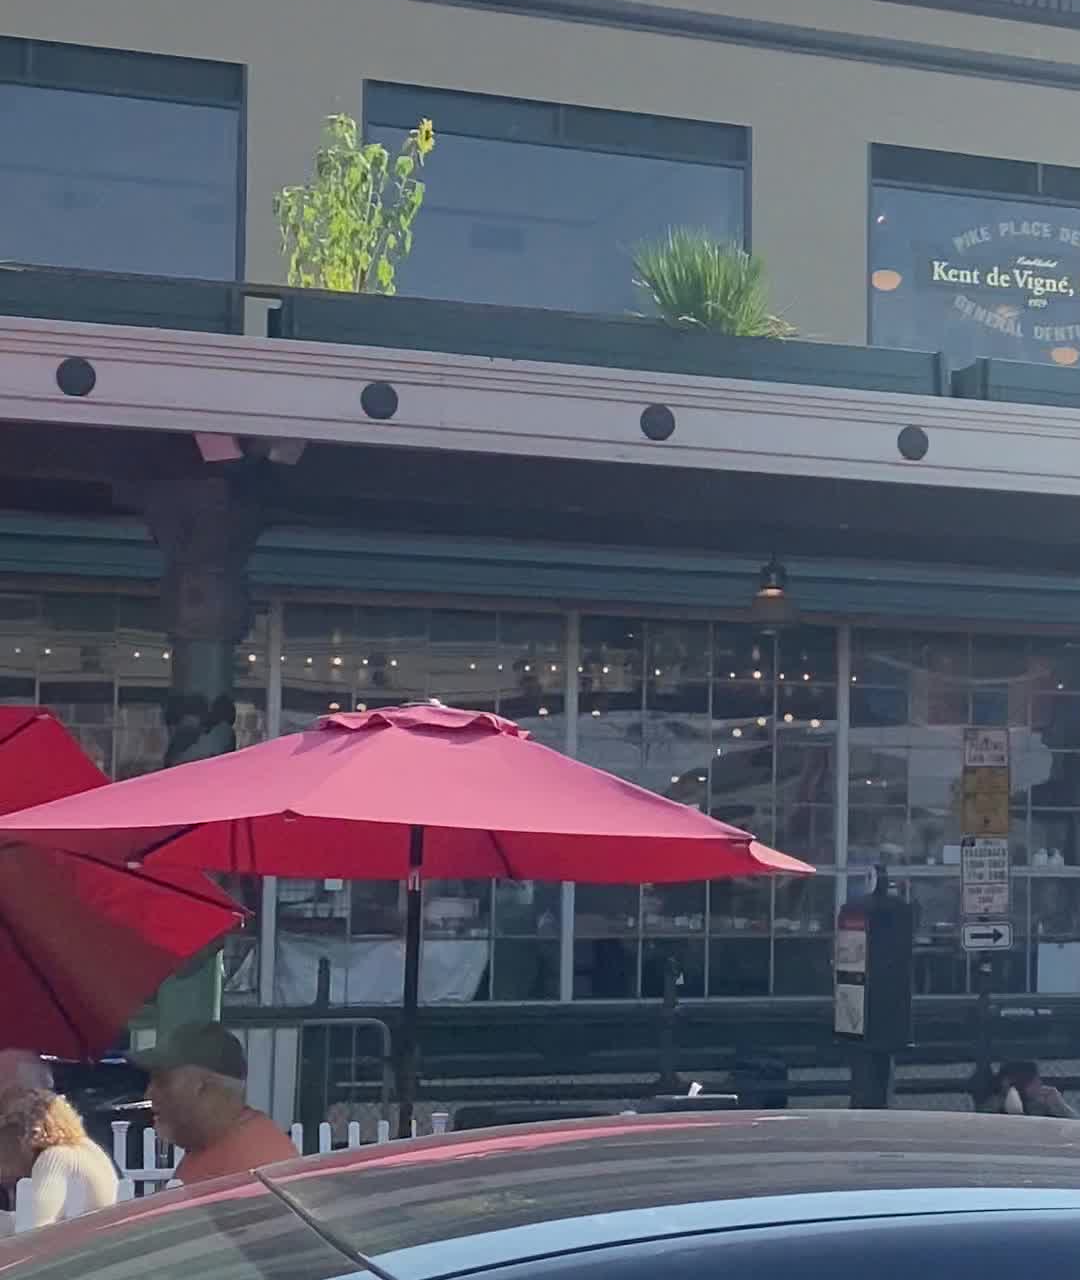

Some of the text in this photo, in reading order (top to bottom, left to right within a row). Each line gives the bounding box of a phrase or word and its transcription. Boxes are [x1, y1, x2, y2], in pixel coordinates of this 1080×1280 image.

[953, 225, 991, 254] PIKE
[999, 220, 1051, 240] PLACE
[932, 260, 980, 285] Kent
[986, 266, 1011, 288] de
[953, 294, 1024, 338] GENERAL
